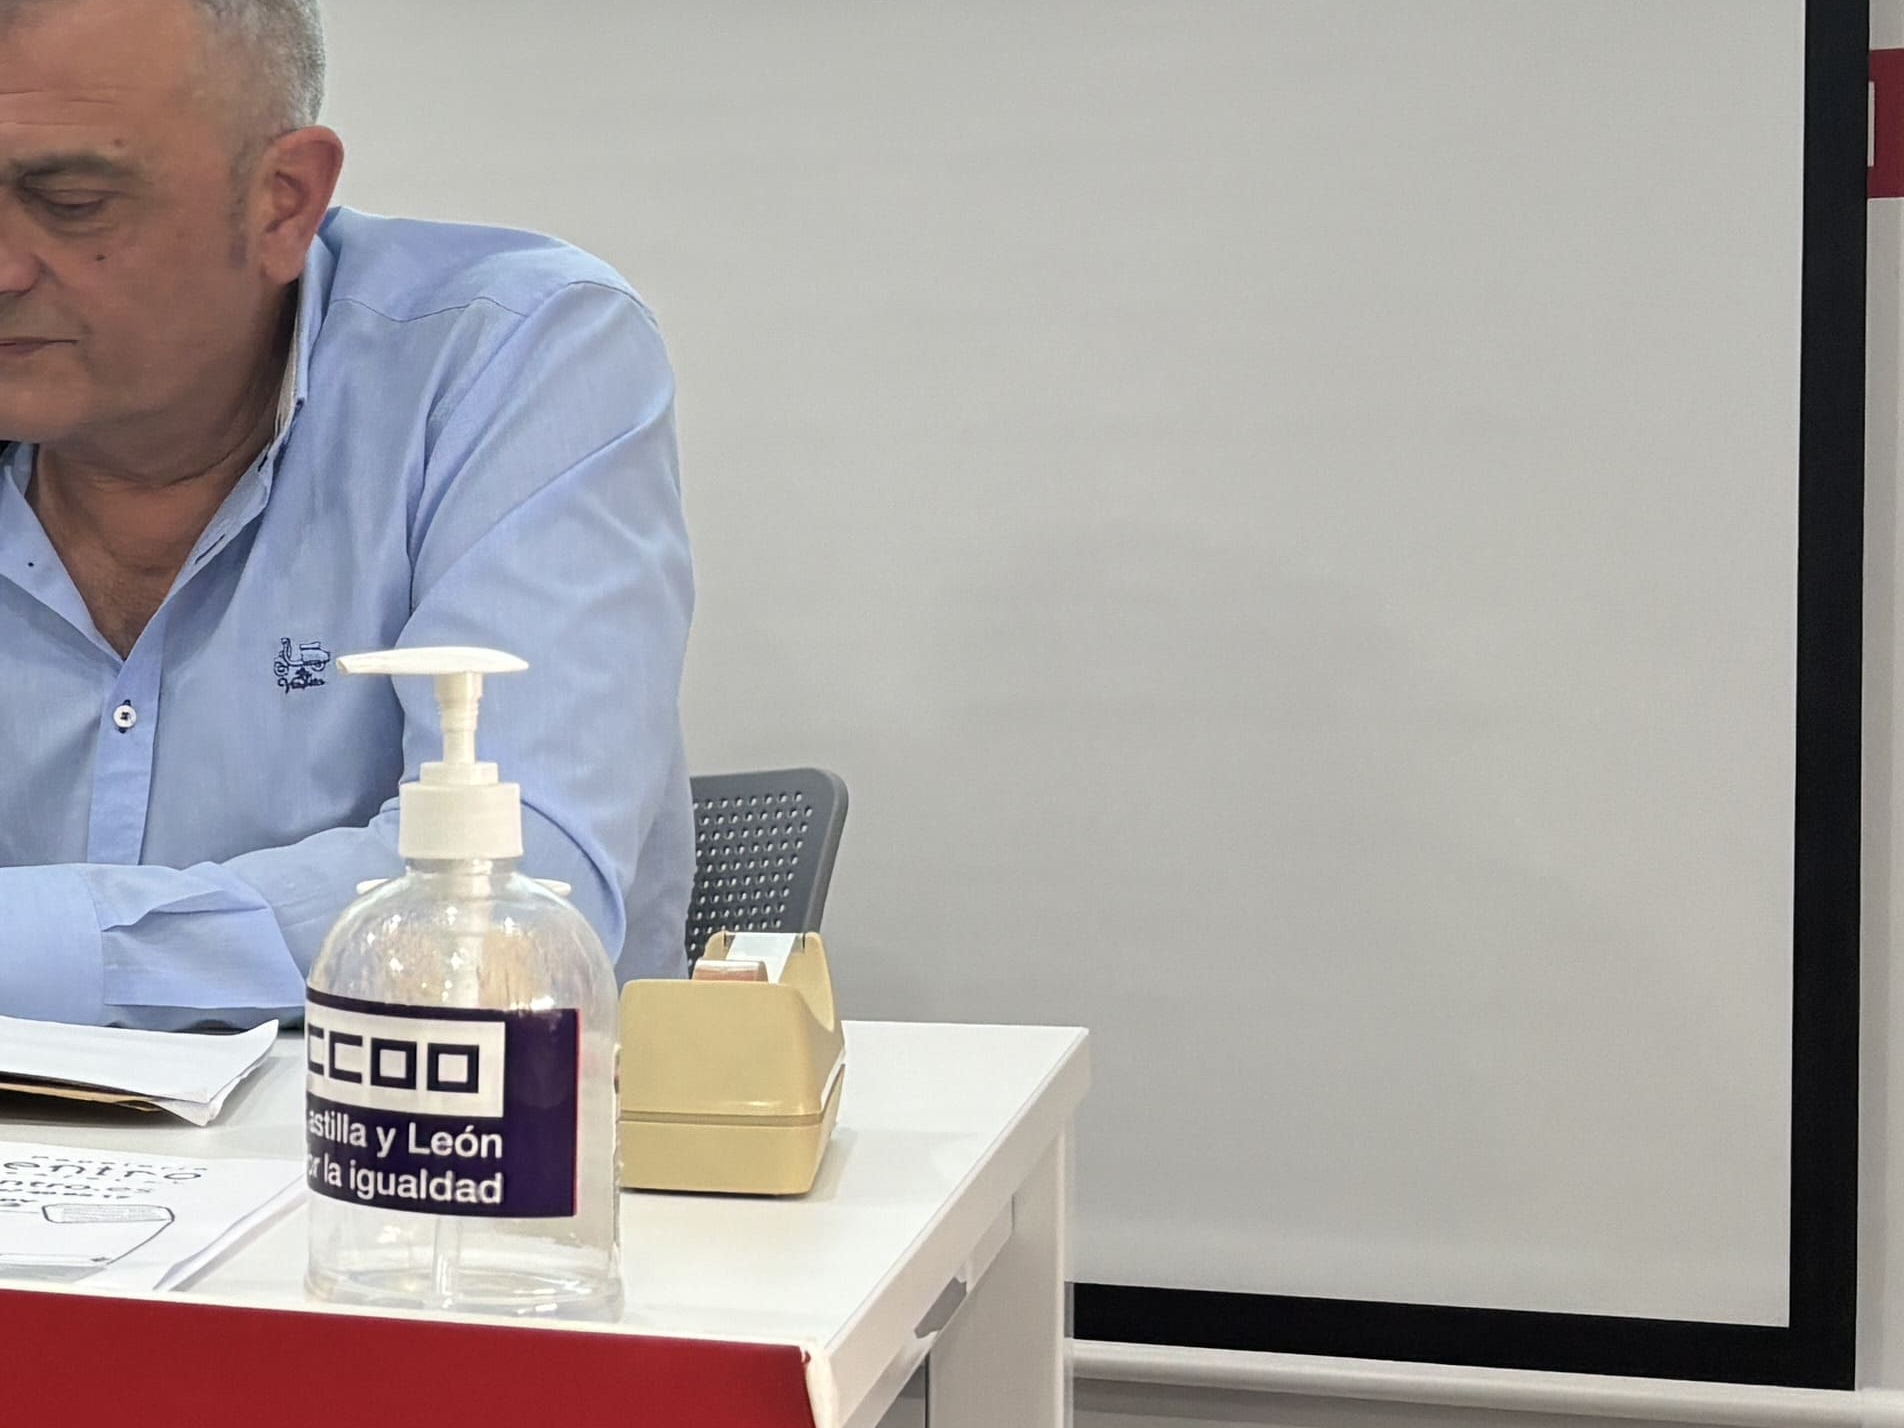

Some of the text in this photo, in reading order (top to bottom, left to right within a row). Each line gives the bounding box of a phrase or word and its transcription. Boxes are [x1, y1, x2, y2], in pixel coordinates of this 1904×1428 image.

[376, 1126, 397, 1158] y
[408, 1122, 503, 1159] León
[324, 1152, 342, 1188] la
[349, 1159, 503, 1205] igualdad
